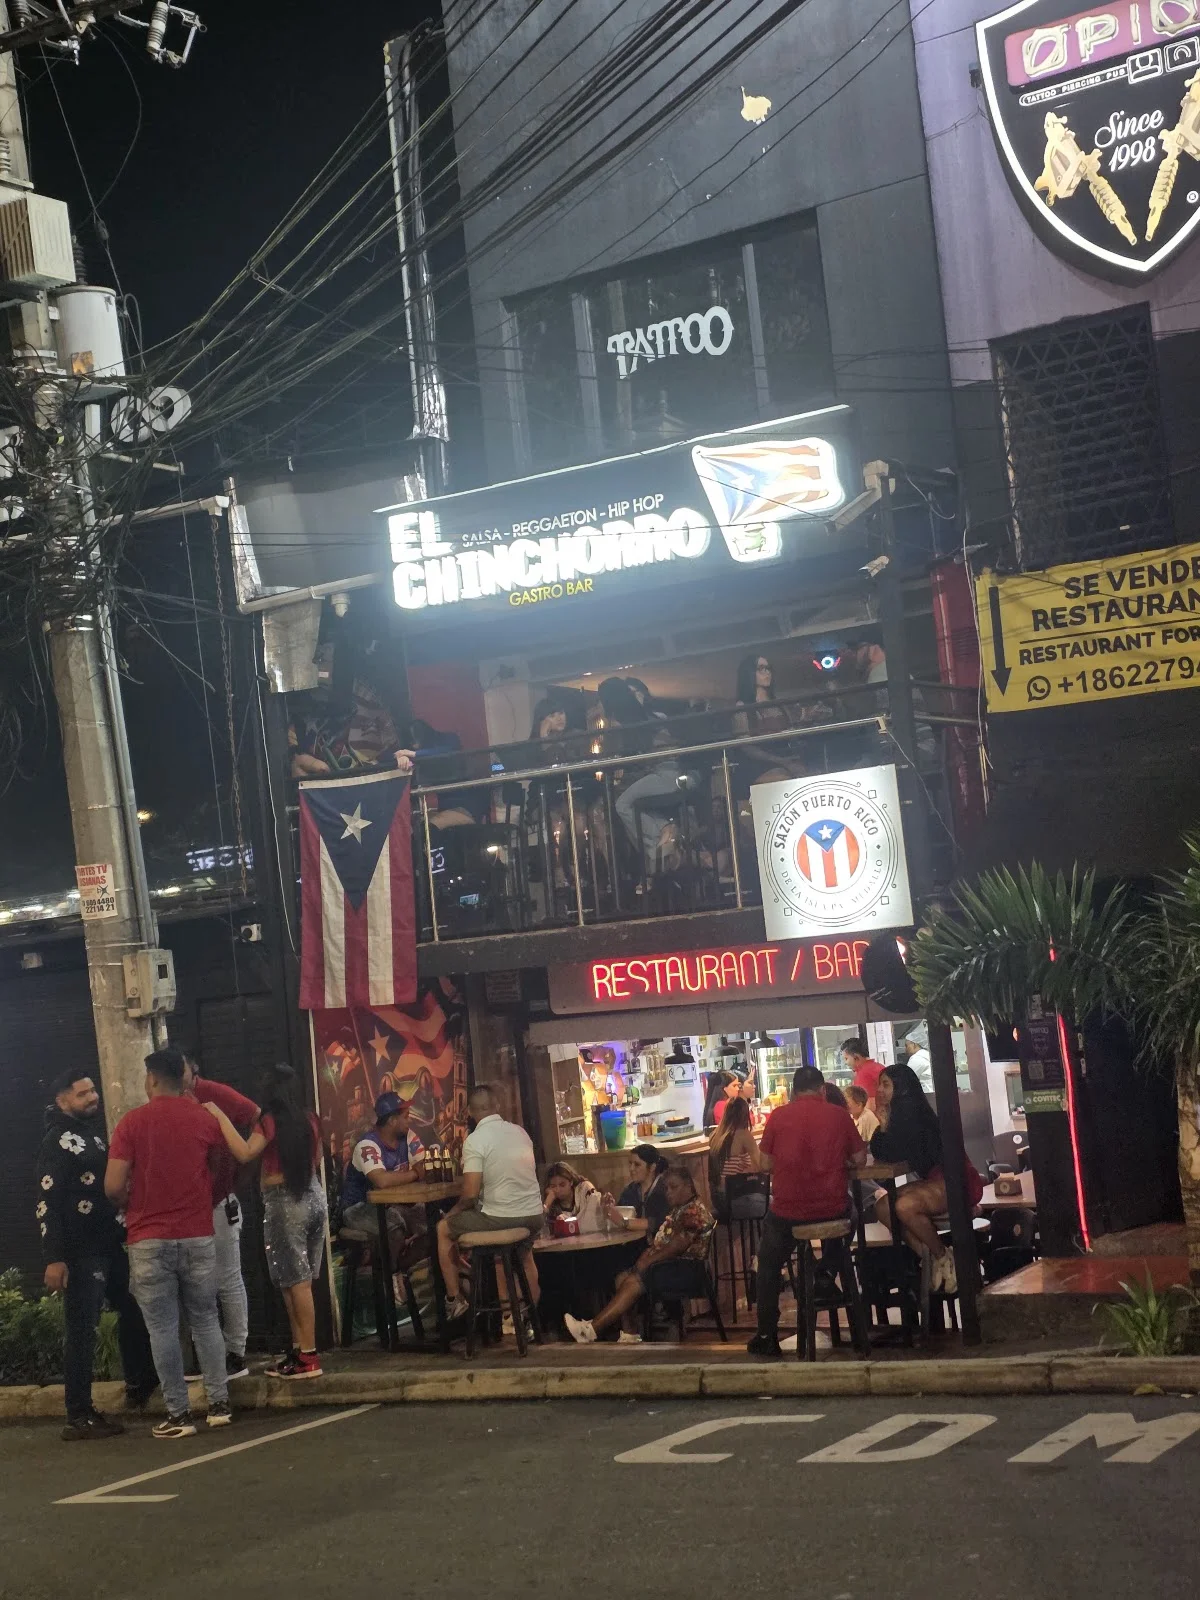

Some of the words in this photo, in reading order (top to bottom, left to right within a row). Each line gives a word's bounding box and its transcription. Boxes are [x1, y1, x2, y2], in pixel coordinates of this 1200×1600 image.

[1026, 88, 1056, 103] TATTOO
[1062, 76, 1101, 93] PIERCING
[1095, 109, 1164, 148] Since
[1109, 137, 1156, 172] 1998
[607, 306, 735, 379] TATTOO
[388, 511, 453, 563] EL
[462, 528, 502, 548] SALSA
[512, 508, 597, 538] REGGAETON
[608, 501, 630, 519] HIP
[633, 493, 664, 513] HOP
[392, 508, 711, 609] CHINCHORRO
[509, 584, 563, 606] GASTRO
[567, 578, 593, 596] BAR
[1064, 573, 1100, 599] SE
[1019, 632, 1156, 665] RESTAURANT
[1162, 625, 1200, 645] FOR
[802, 794, 852, 812] PUERTO
[781, 870, 791, 885] DE
[592, 949, 778, 999] RESTAURANT
